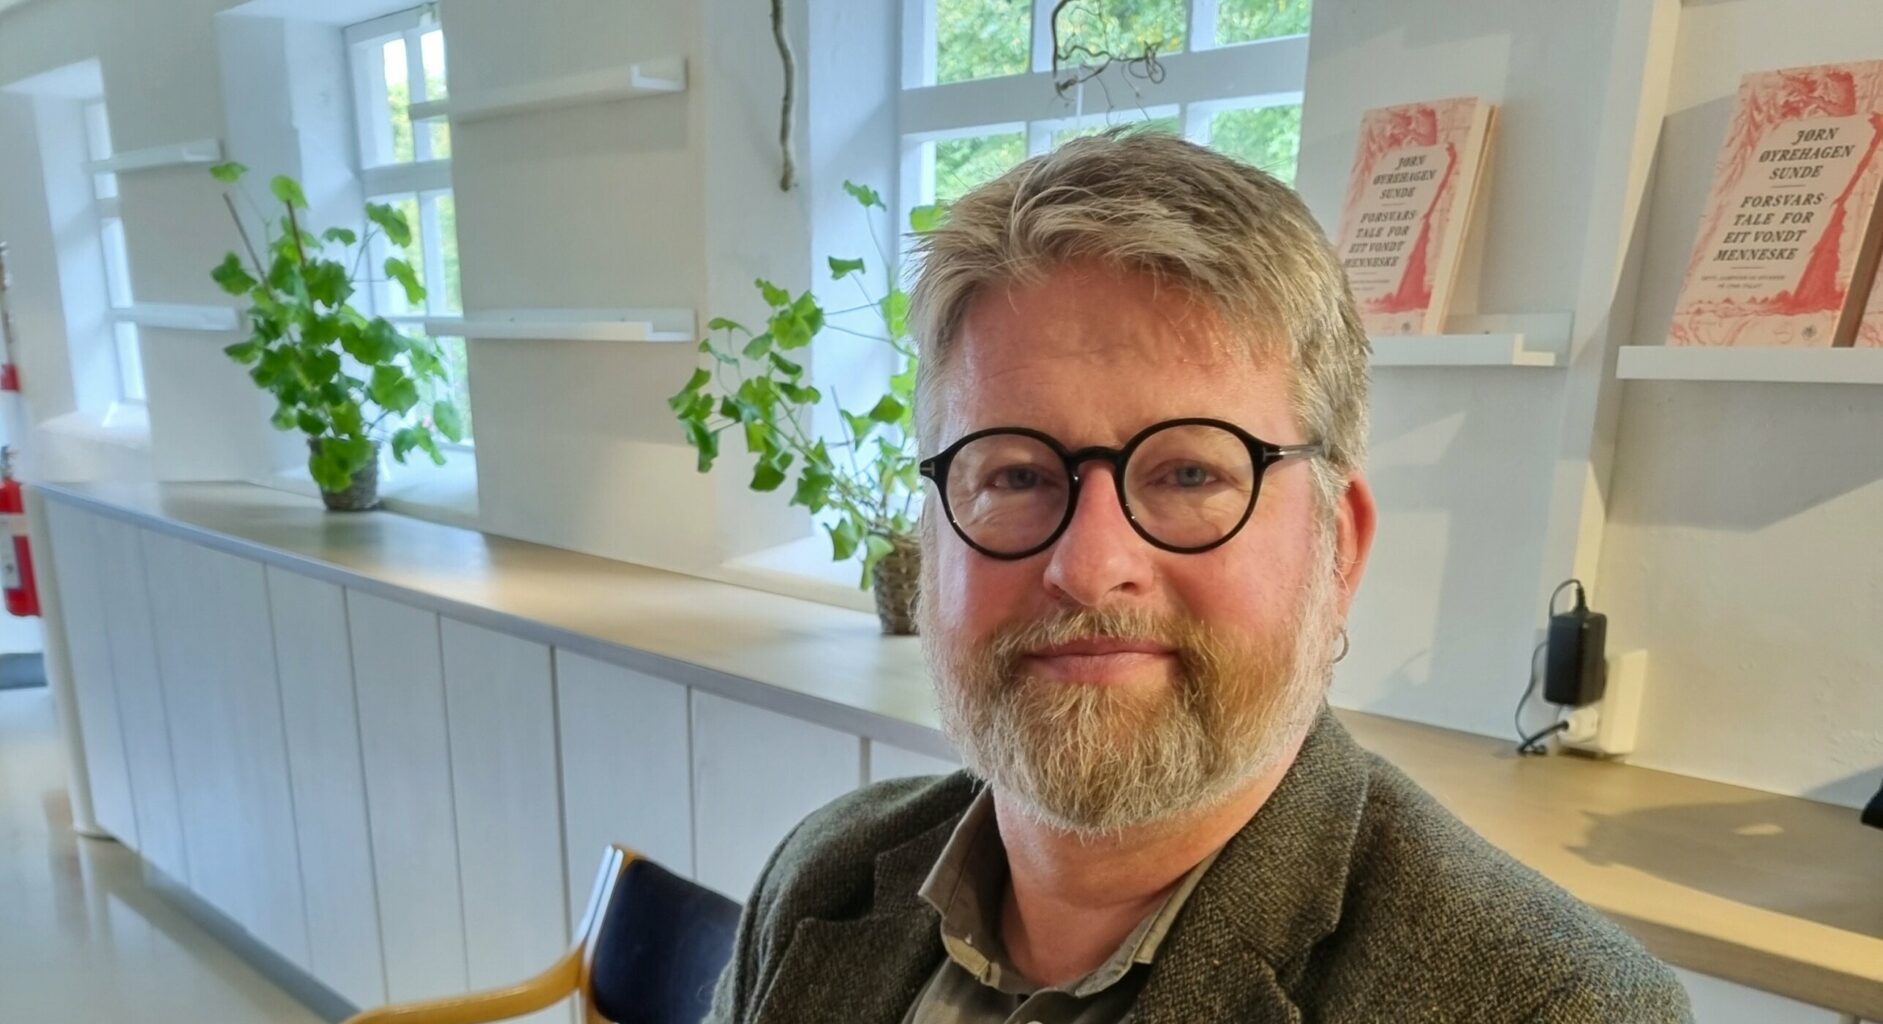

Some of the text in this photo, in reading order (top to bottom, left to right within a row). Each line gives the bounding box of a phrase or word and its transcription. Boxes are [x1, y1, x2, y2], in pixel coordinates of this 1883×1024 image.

[1791, 127, 1840, 145] JØRN
[1759, 145, 1856, 162] ØYREHAGEN
[1395, 155, 1427, 171] JØRN
[1373, 169, 1437, 185] ØYREHAGEN
[1769, 165, 1824, 180] SUNDE
[1379, 187, 1416, 199] SUNDE
[1733, 211, 1815, 226] TALE FOR
[1355, 225, 1410, 238] TALE FOR
[1723, 229, 1807, 244] EIT VONDT
[1348, 240, 1405, 254] EIT VONDT
[1712, 248, 1799, 261] MENNESKE
